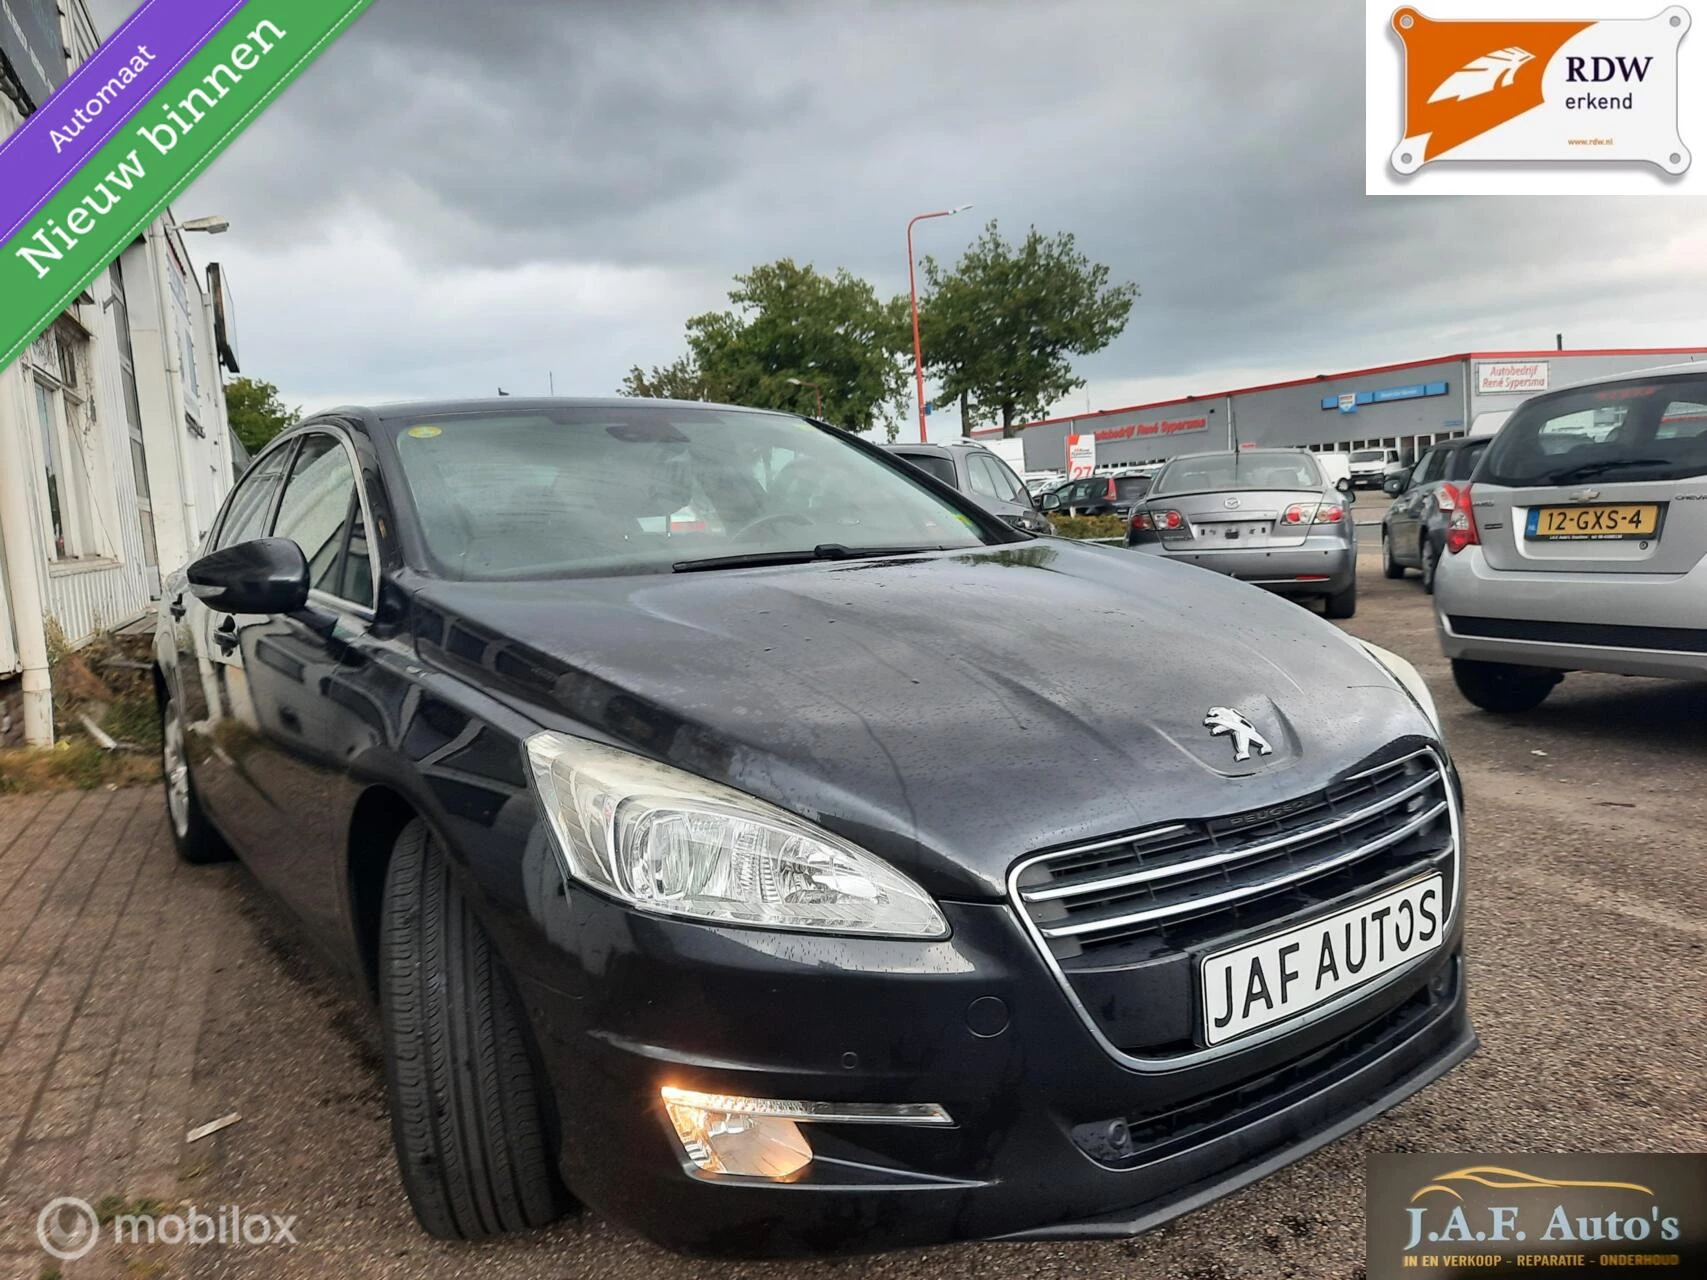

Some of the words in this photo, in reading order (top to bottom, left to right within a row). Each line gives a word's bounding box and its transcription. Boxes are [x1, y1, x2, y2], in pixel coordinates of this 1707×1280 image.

[1074, 466, 1092, 480] 27
[1547, 509, 1642, 531] 12-GXS-4
[1214, 942, 1300, 1028] JAF
[1315, 889, 1437, 991] AUTOS
